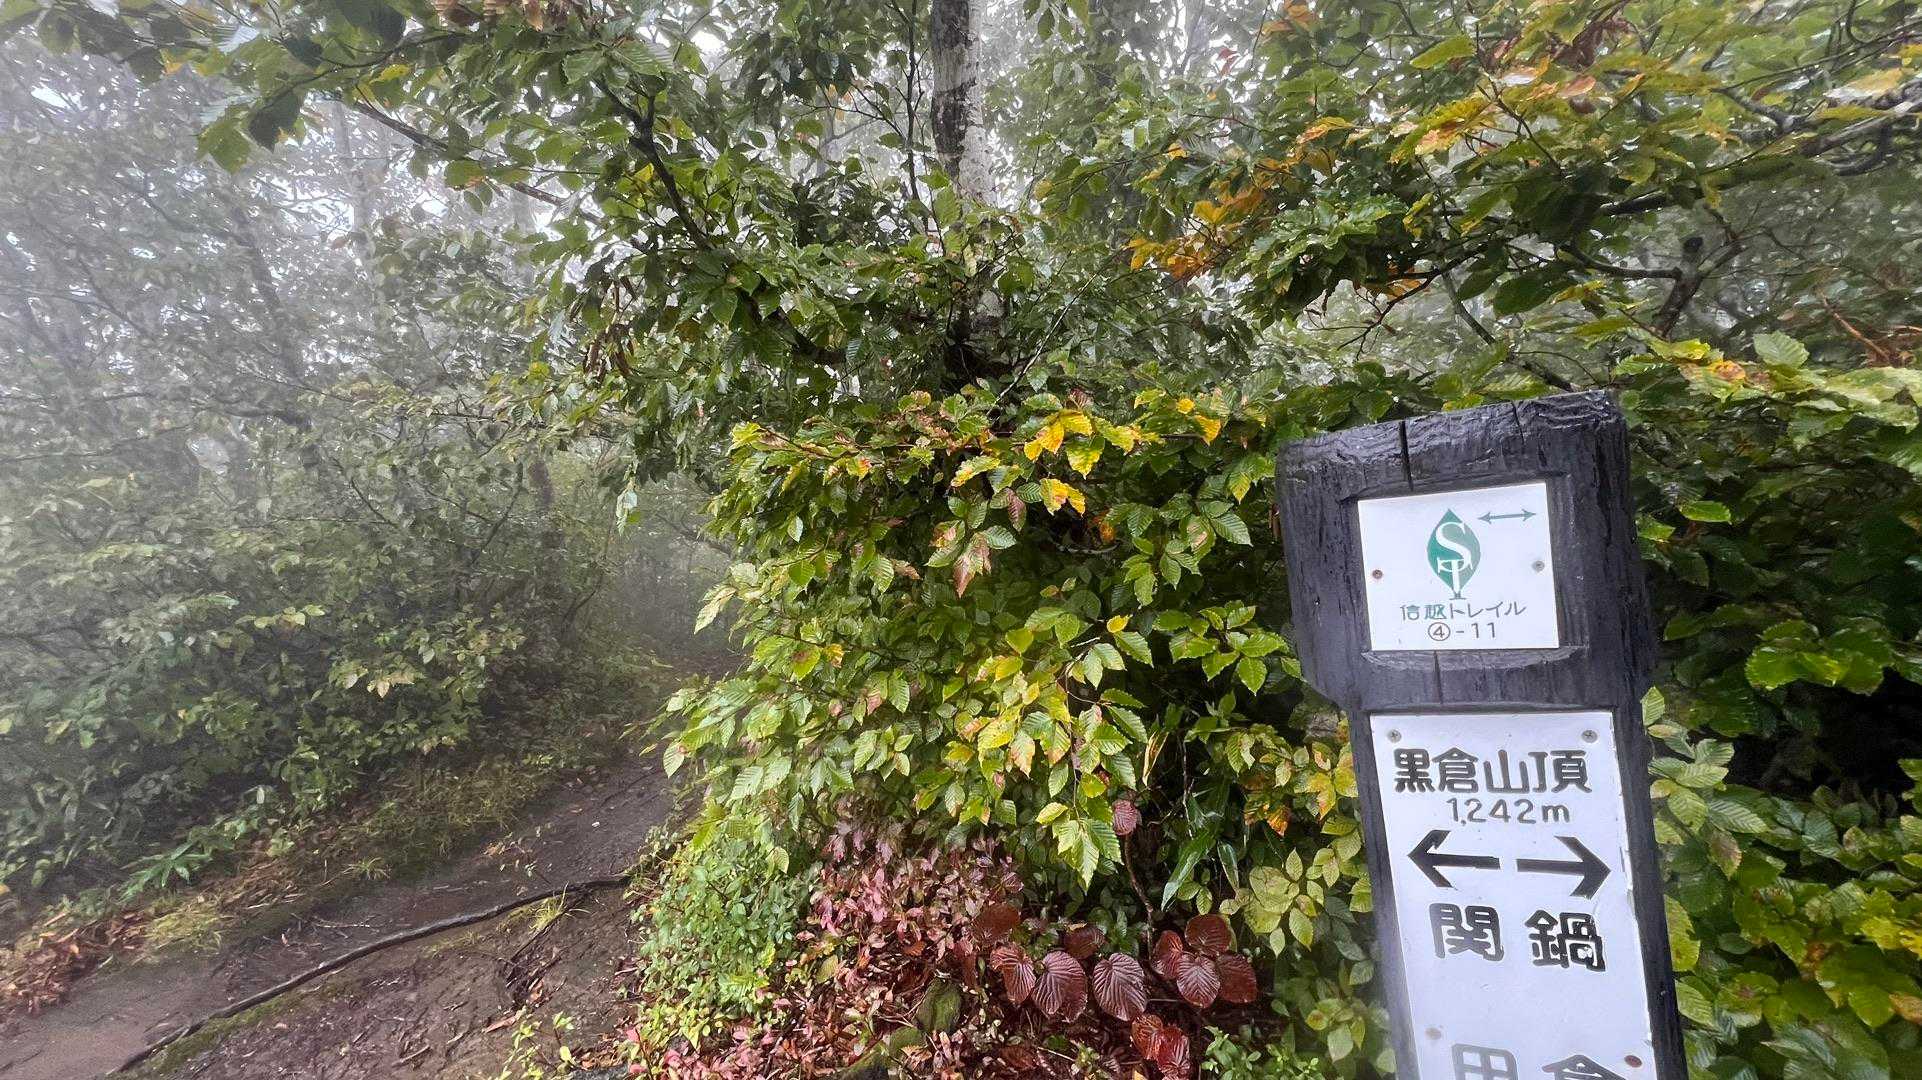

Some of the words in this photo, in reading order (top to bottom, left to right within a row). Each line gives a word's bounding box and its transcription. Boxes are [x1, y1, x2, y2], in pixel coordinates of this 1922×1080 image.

[1400, 601, 1527, 621] 信越トレイル
[1393, 747, 1593, 794] 黒倉山頂
